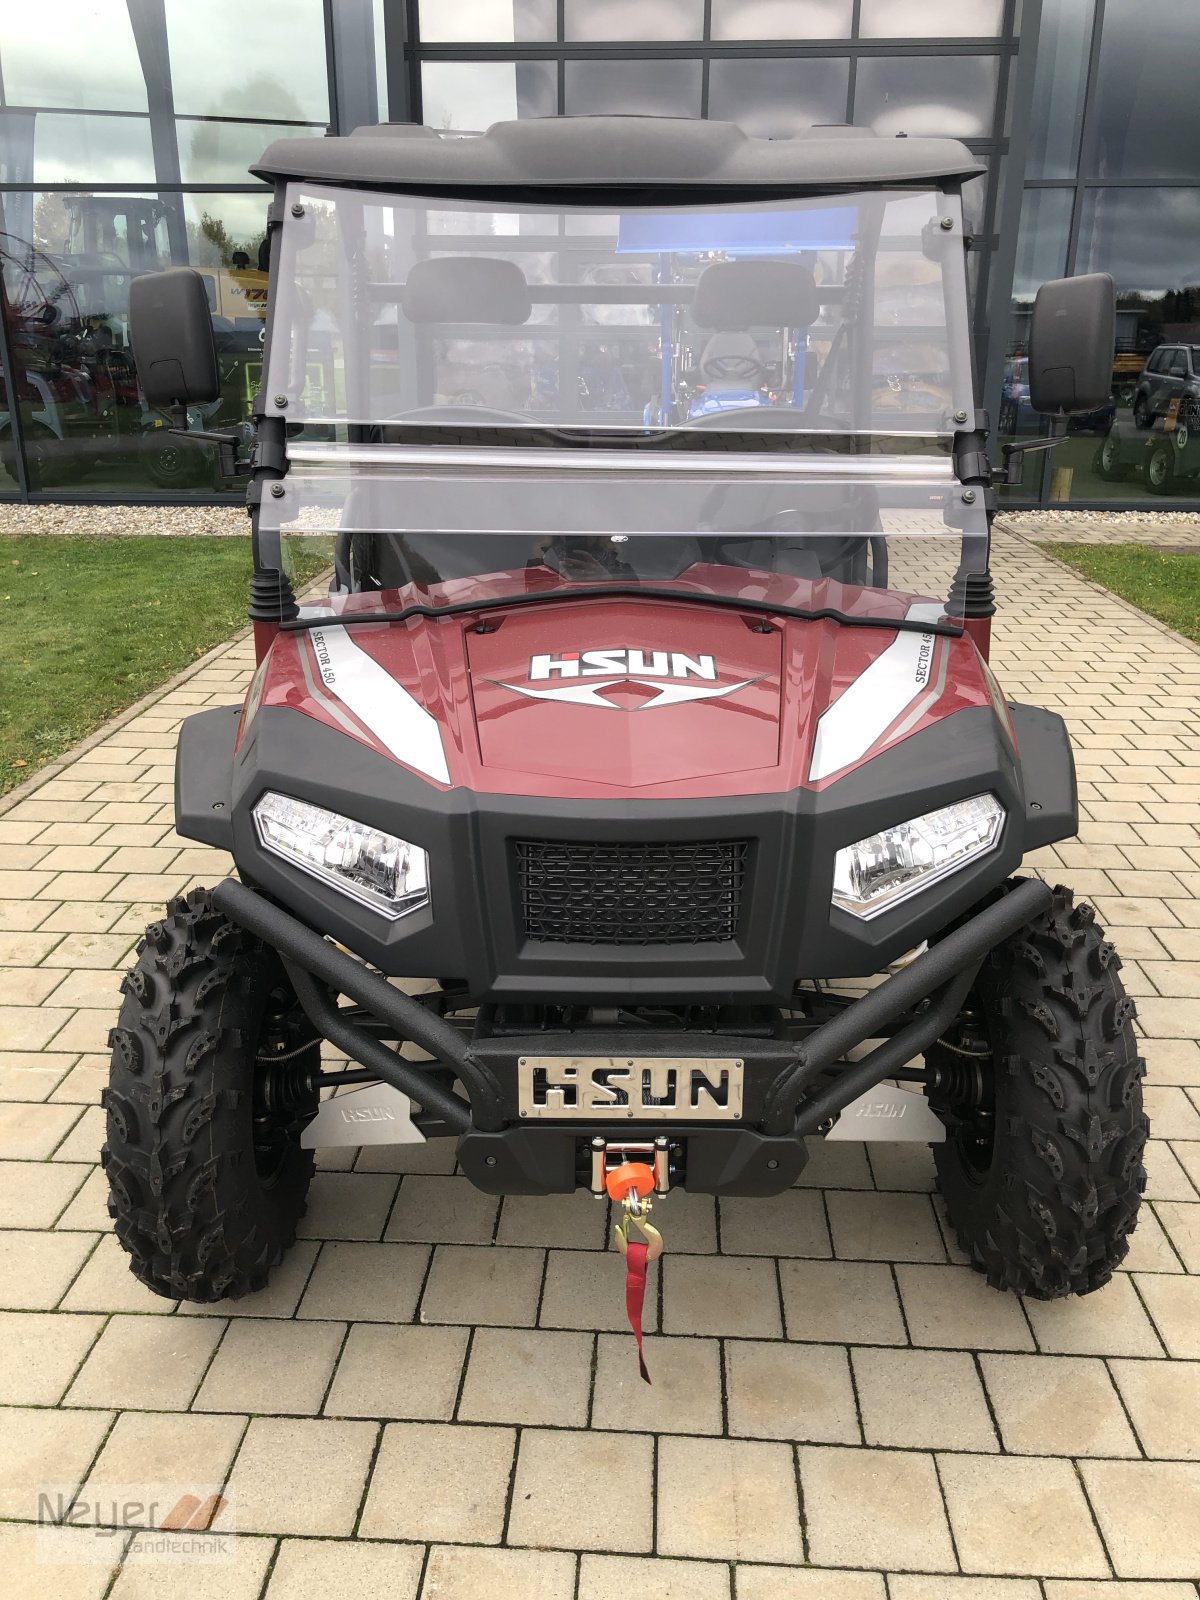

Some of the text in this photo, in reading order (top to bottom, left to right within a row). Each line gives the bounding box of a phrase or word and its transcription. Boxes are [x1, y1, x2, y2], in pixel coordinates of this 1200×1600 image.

[313, 631, 336, 684] SECTOR 450
[529, 649, 719, 680] HSUN
[915, 632, 933, 684] SECTOR 45
[532, 1067, 730, 1109] HSUN
[341, 1106, 396, 1123] HSUN
[855, 1103, 907, 1118] HSUN
